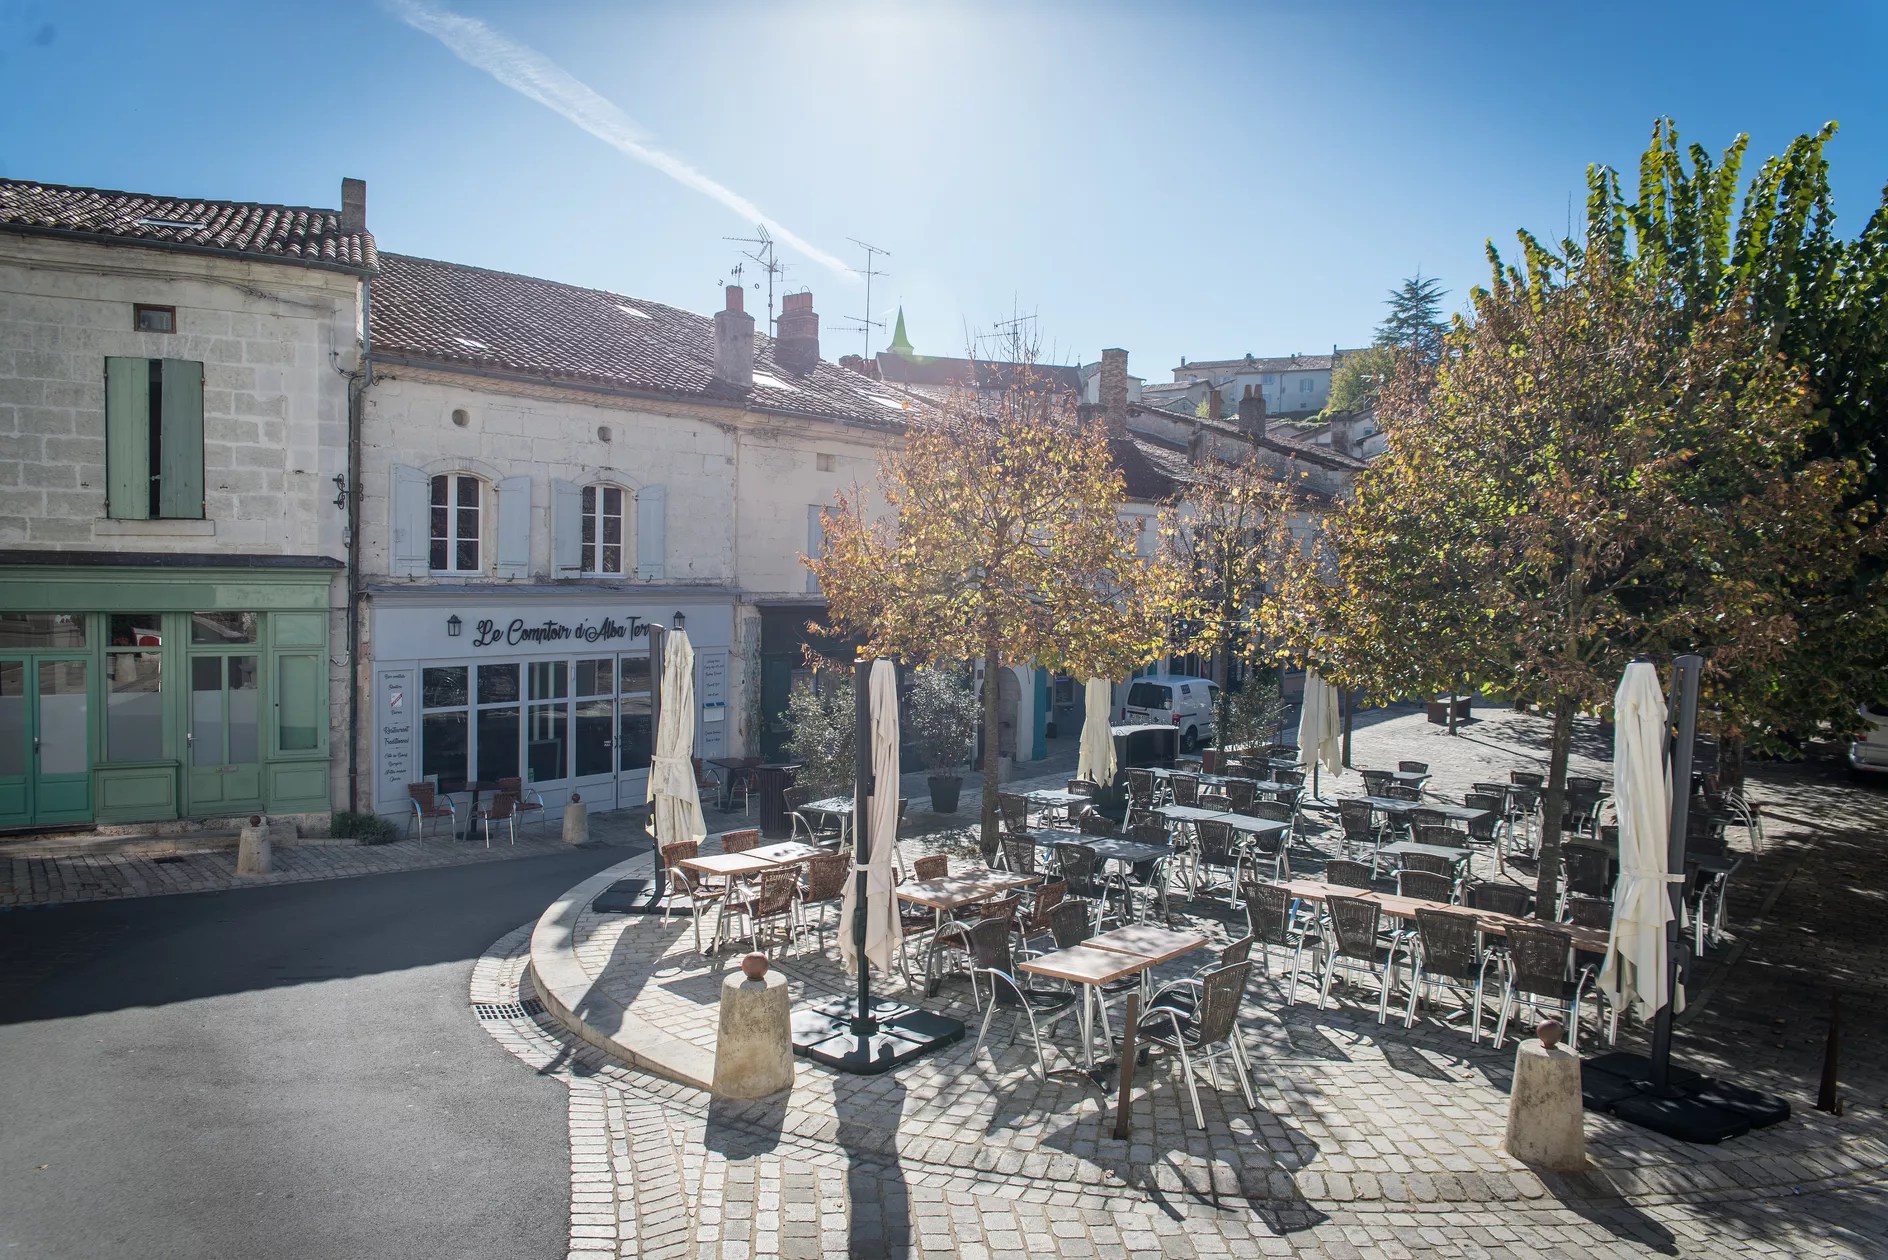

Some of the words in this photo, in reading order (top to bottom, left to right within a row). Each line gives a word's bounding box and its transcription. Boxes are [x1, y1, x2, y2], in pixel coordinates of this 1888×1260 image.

[473, 619, 504, 647] Le
[507, 618, 572, 645] Comptoir
[575, 616, 627, 643] d'Alba
[625, 615, 650, 641] Ter
